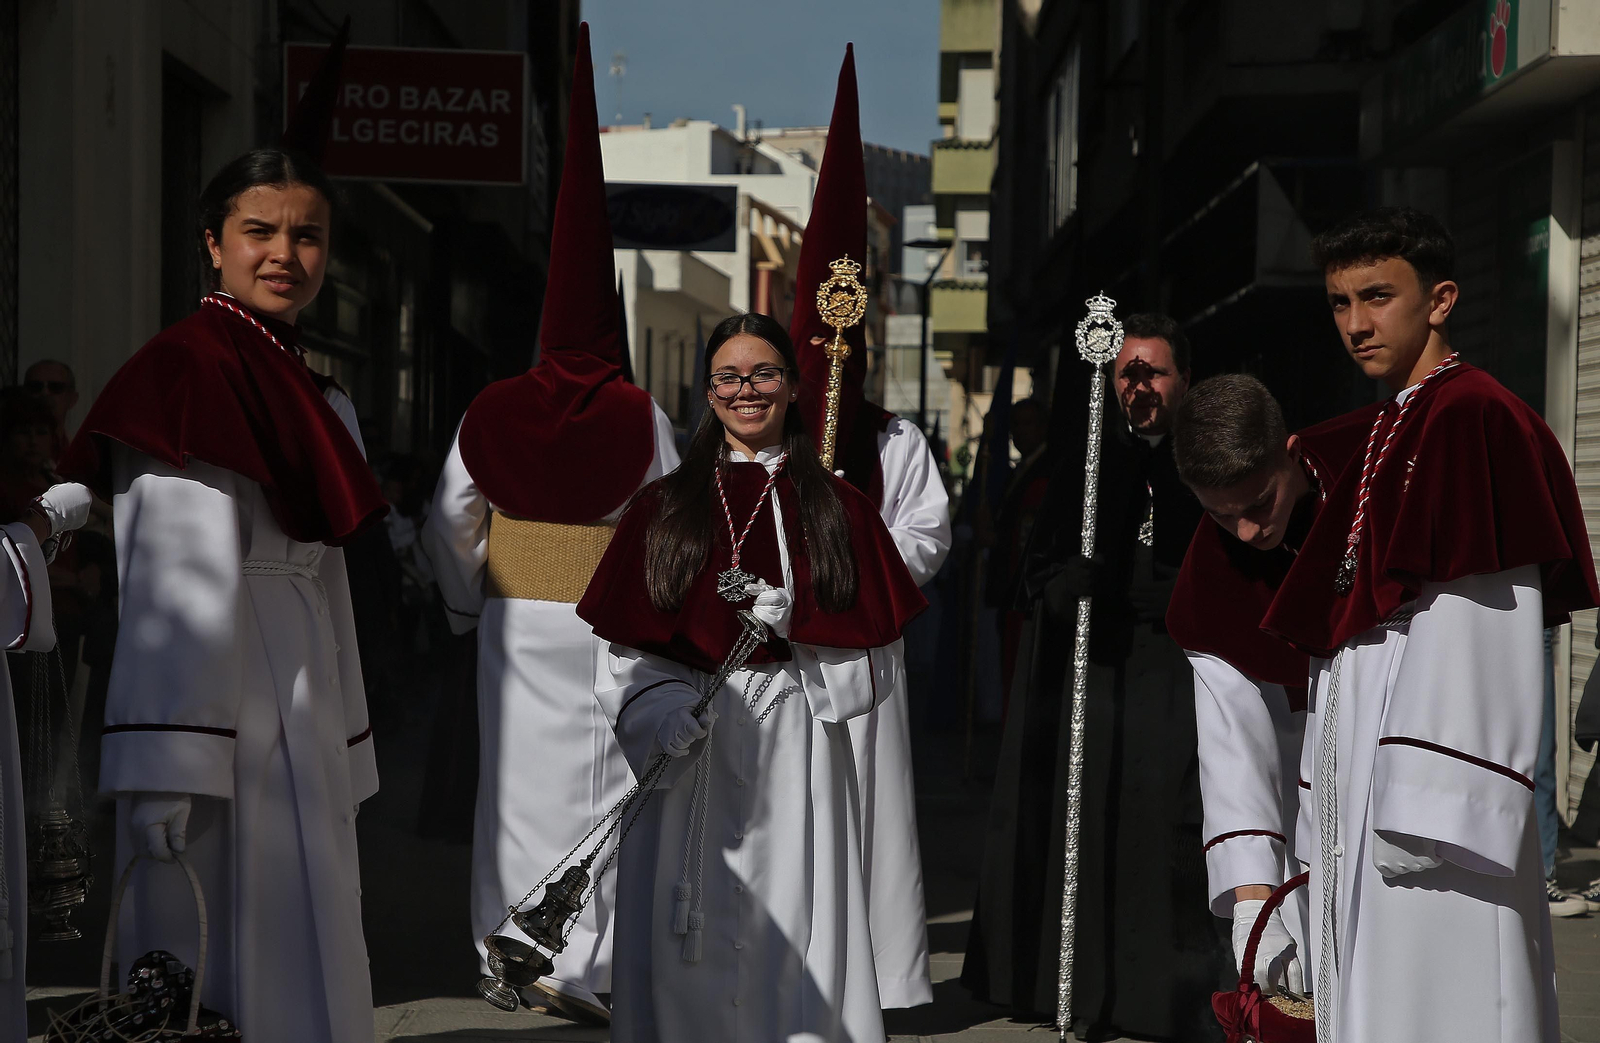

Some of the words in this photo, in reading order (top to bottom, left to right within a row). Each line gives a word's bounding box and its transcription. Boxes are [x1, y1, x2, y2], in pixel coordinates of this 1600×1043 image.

[298, 81, 391, 110] RO
[399, 85, 512, 114] BAZAR
[330, 117, 499, 148] LGECIRAS
